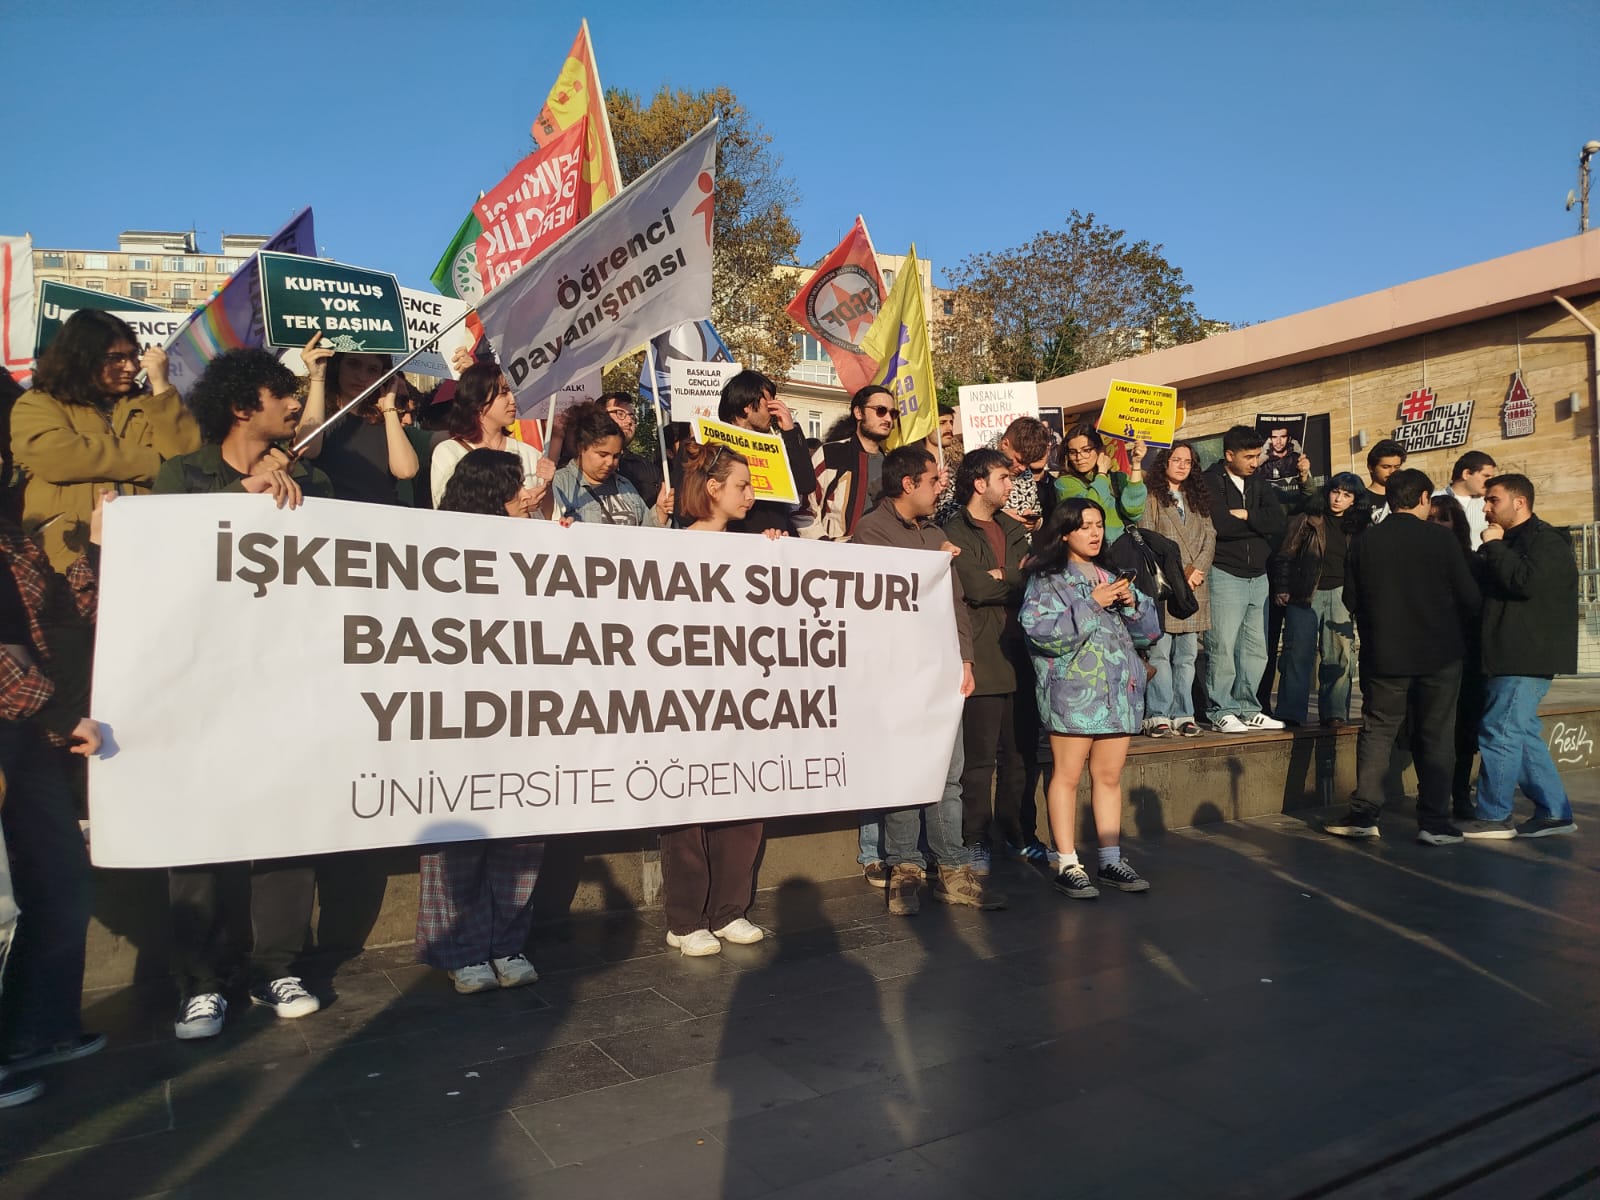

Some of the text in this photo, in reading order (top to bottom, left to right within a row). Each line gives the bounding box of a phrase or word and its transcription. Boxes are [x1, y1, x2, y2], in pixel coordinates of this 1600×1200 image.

[557, 207, 676, 311] Öğrenci
[284, 276, 384, 299] KURTULUŞ
[320, 297, 361, 312] YOK
[402, 296, 442, 316] ENCE
[282, 315, 394, 333] TEK BAŞINA
[507, 247, 688, 387] Dayanışması
[674, 387, 722, 397] YILDIRAMAYA
[686, 368, 721, 377] BASKILAR
[216, 520, 920, 618] İŞKENCE YAPMAK SUÇTUR!
[343, 614, 847, 678] BASKILAR GENÇLİĞİ
[360, 685, 838, 742] YILDIRAMAYACAK!
[351, 751, 848, 819] ÜNİVERSİTE ÖĞRENCİLERİ
